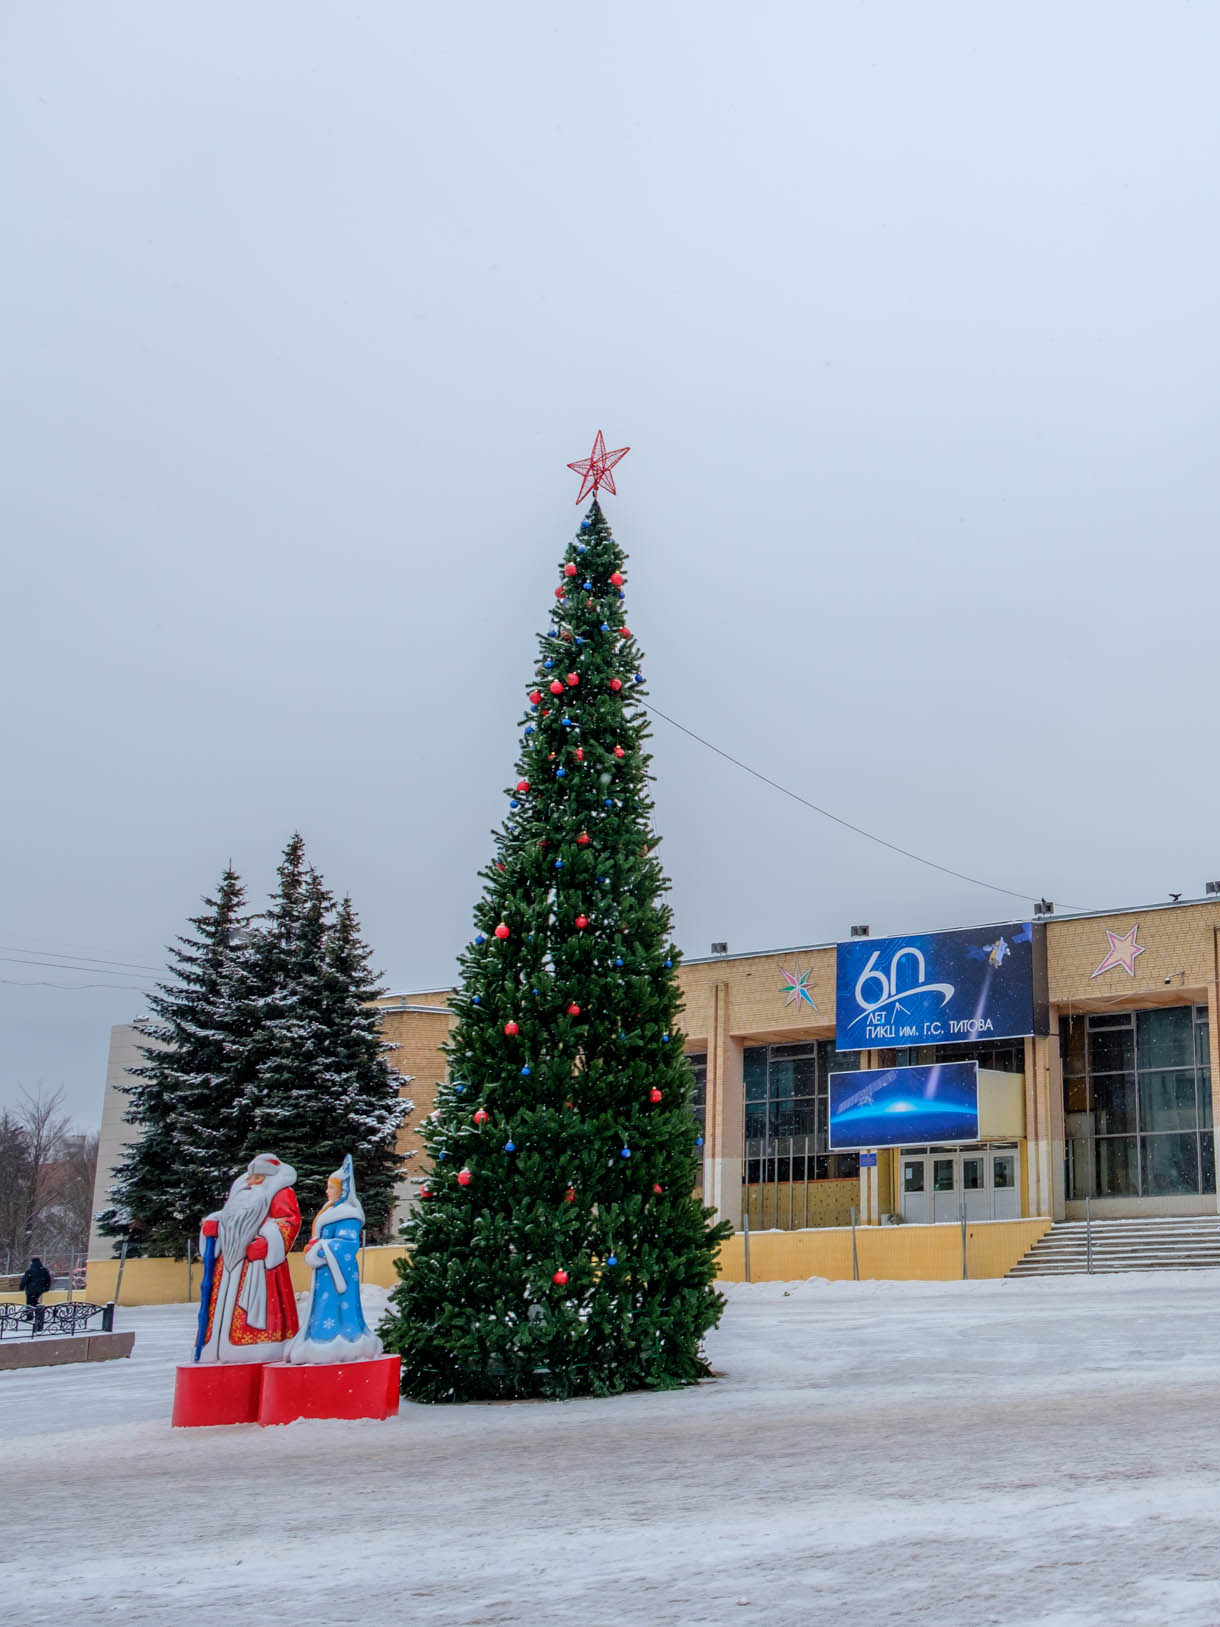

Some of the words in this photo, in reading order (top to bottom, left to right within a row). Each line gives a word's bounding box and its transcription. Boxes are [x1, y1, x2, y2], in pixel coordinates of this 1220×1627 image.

[855, 946, 926, 1010] 60
[866, 1024, 896, 1039] ГИКЦ
[923, 1021, 944, 1035] Г.С.
[949, 1018, 994, 1033] ТИТОВА
[867, 1011, 887, 1025] ЛЕТ
